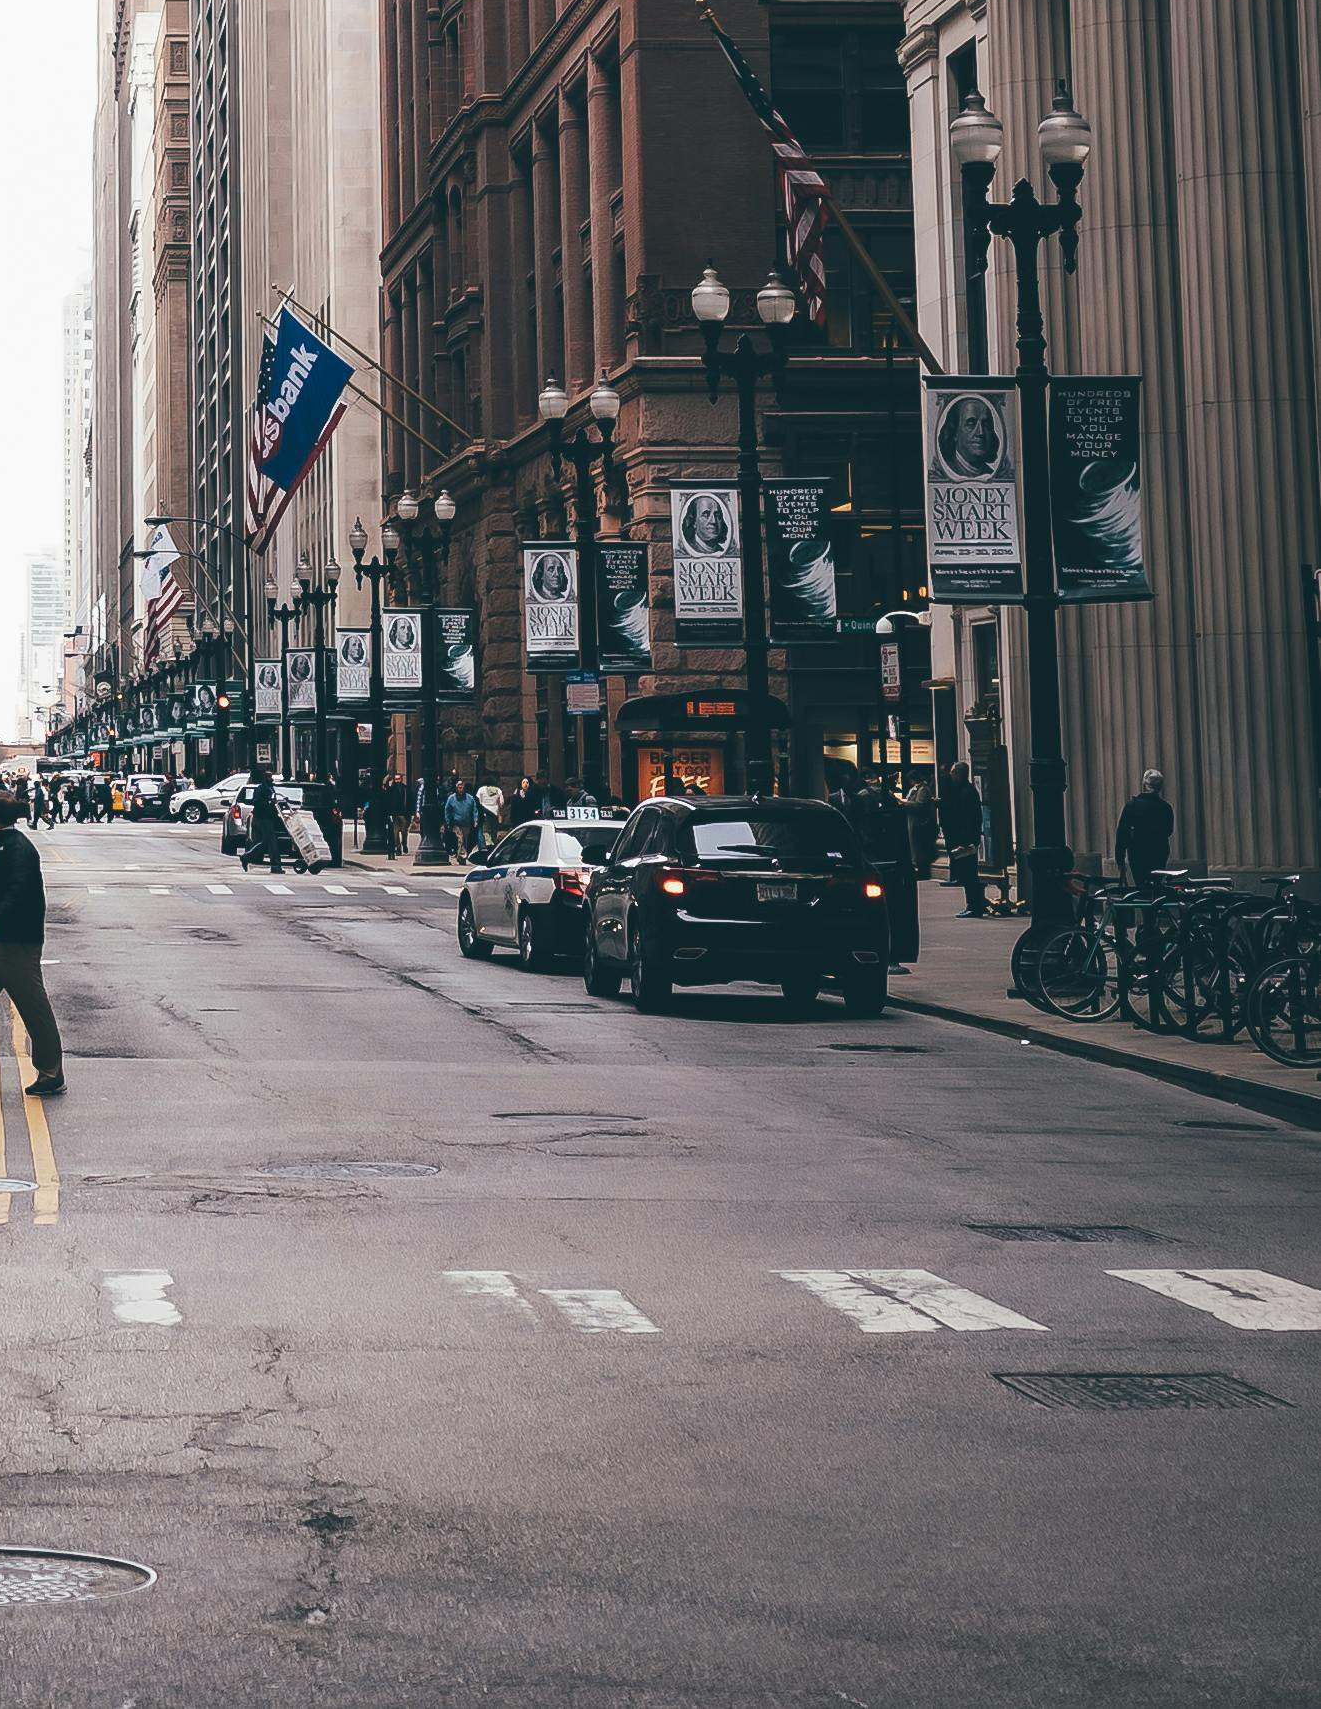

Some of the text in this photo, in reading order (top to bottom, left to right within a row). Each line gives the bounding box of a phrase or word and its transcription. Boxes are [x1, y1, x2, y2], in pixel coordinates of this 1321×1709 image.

[1058, 390, 1131, 398] HUNDREDS
[1068, 407, 1120, 415] EVENTS
[1081, 424, 1107, 432] YOU
[1066, 433, 1122, 441] MANAGE
[1076, 441, 1112, 449] YOUR
[1070, 450, 1118, 458] MONEY
[933, 487, 1010, 504] MONEY
[933, 503, 1011, 520] SMART
[933, 520, 1012, 540] WEEK
[679, 561, 737, 573] MONEY
[679, 573, 737, 586] SMART
[679, 586, 738, 601] WEEK
[569, 808, 597, 820] 3154
